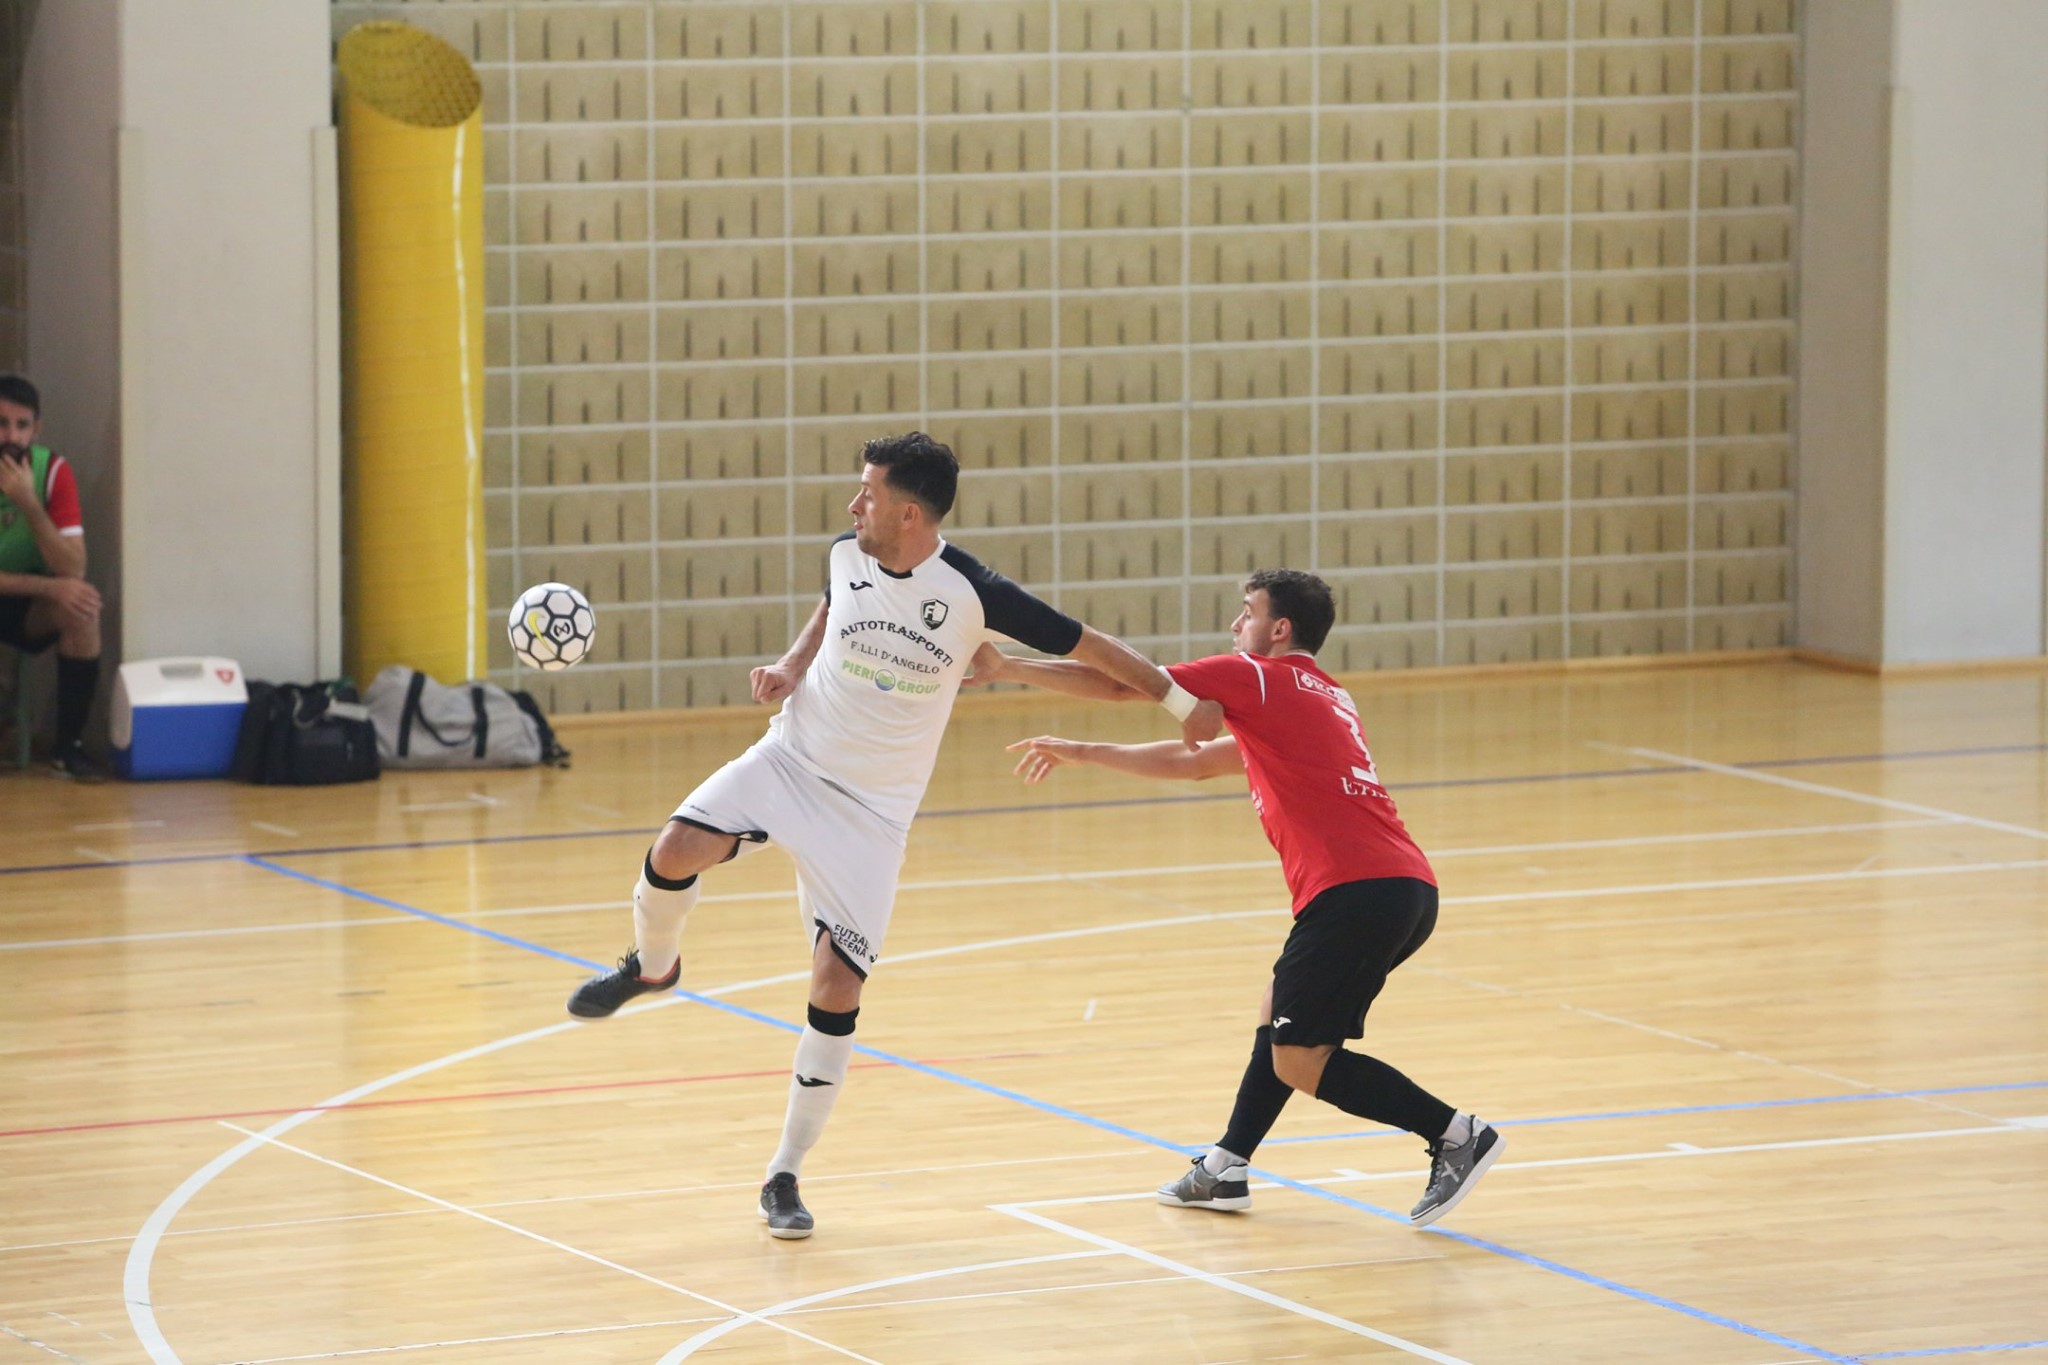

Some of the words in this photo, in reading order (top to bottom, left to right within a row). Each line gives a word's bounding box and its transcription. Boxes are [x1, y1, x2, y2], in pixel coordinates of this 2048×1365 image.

[840, 620, 954, 668] AUTOTRASPORTI
[850, 641, 878, 657] F.LLI
[881, 651, 940, 675] D'ANGELO
[842, 660, 875, 681] PIERI
[896, 680, 941, 694] GROUP
[834, 924, 869, 950] FUTSAL
